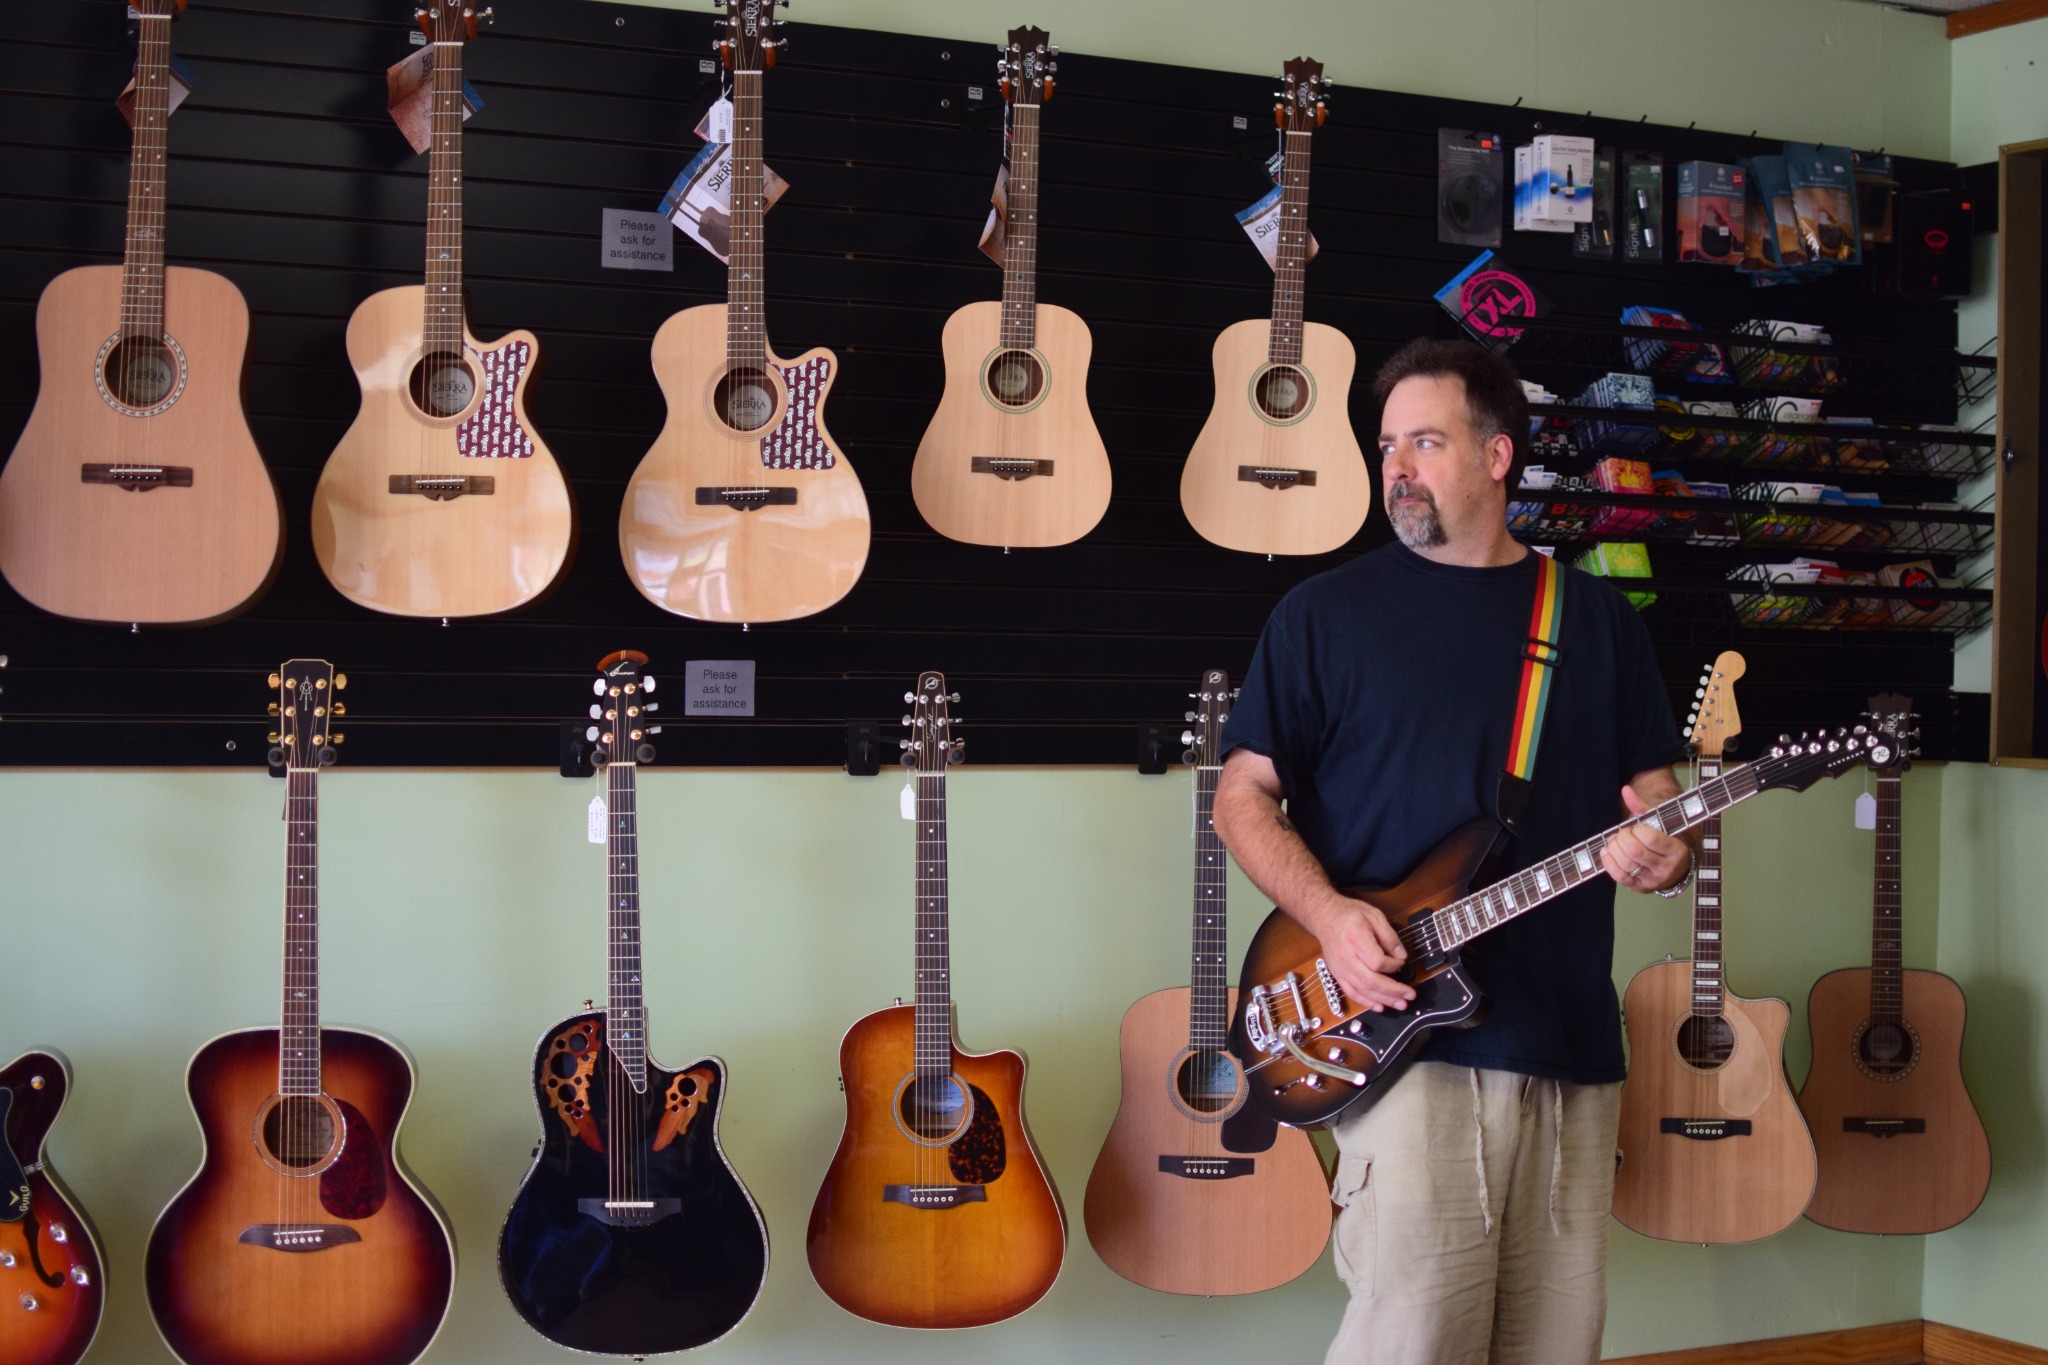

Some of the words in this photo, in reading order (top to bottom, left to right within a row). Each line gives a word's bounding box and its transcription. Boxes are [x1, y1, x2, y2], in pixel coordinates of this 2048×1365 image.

[620, 219, 656, 232] Please
[620, 230, 639, 245] ask
[641, 231, 656, 246] for
[610, 249, 666, 261] assistance
[1476, 288, 1523, 325] XL
[130, 369, 166, 384] SIERRA
[432, 381, 468, 396] SIERRA
[732, 398, 766, 411] SIERRA
[703, 669, 738, 680] Please
[702, 684, 720, 694] ask
[724, 684, 737, 694] for
[693, 698, 747, 709] assistance
[19, 1185, 30, 1212] GUILD
